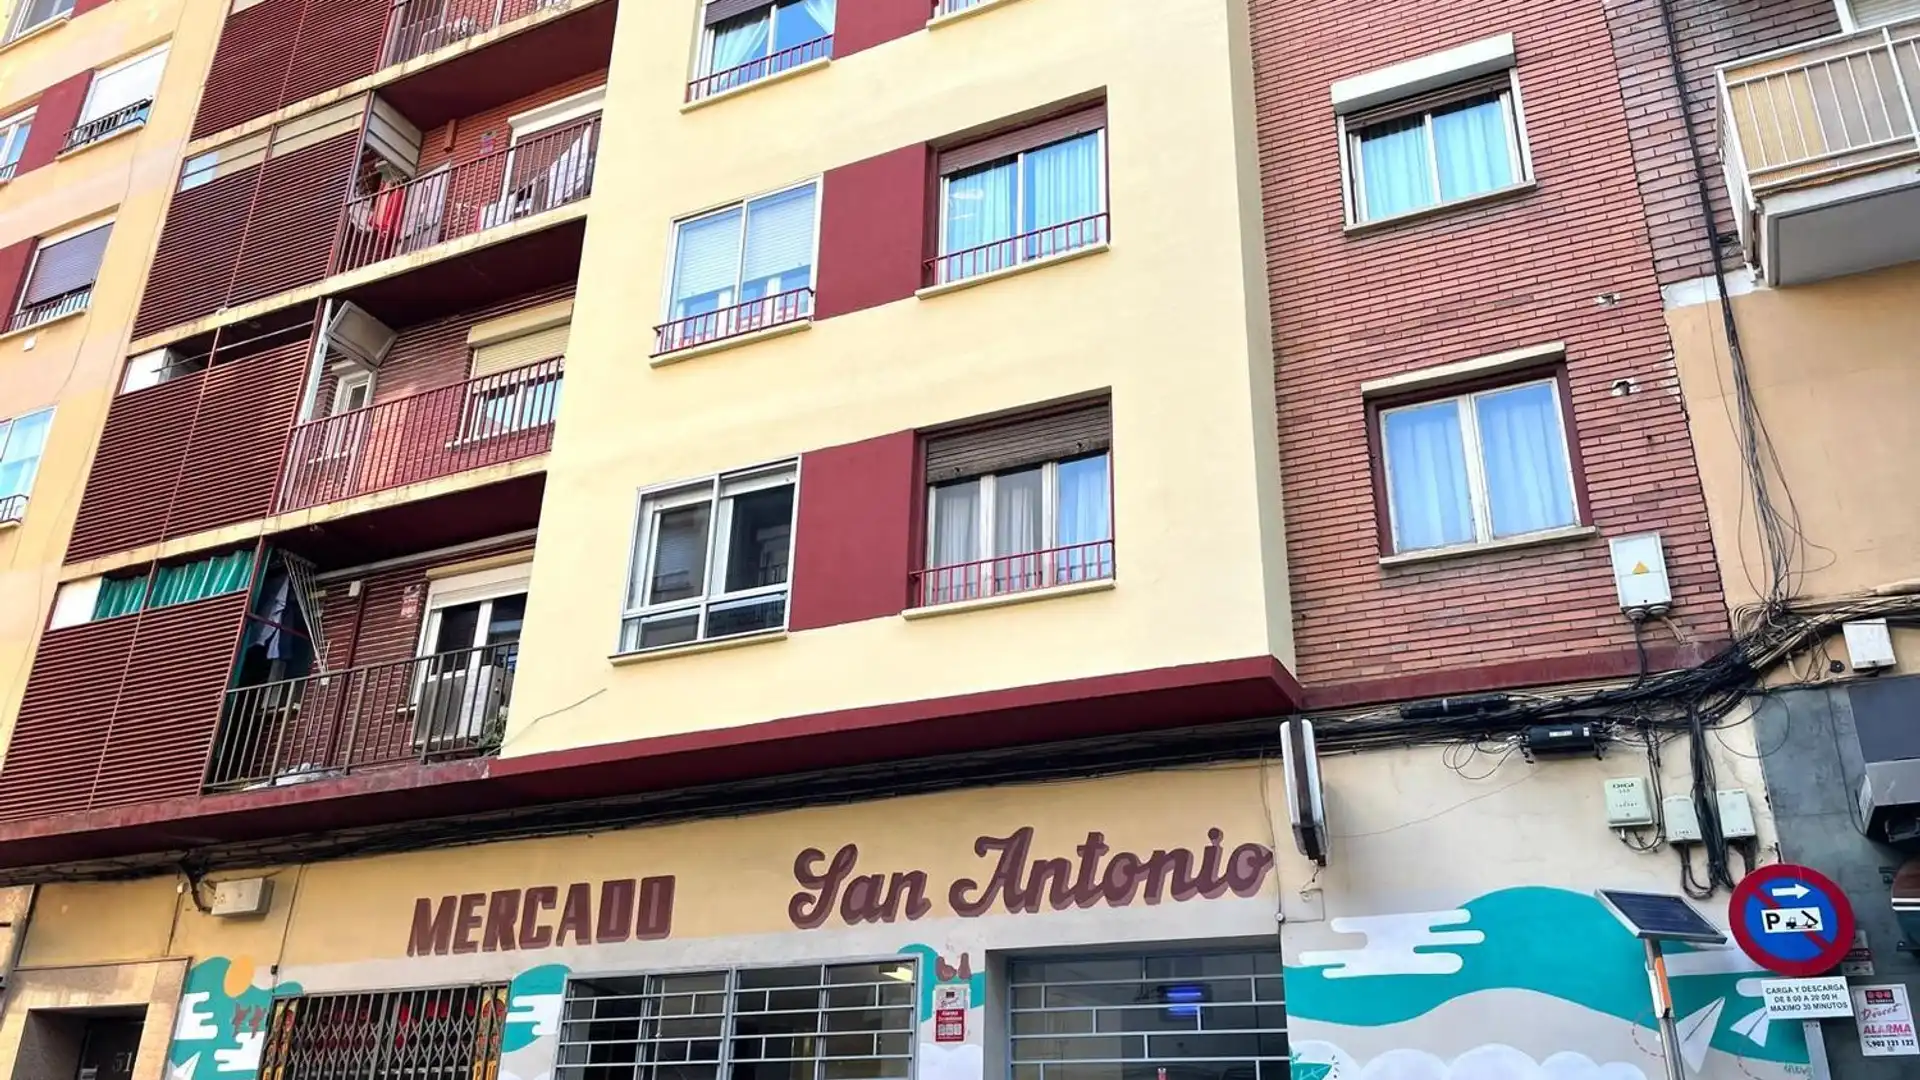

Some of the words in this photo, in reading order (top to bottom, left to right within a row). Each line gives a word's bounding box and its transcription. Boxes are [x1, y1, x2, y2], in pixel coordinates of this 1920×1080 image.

[788, 843, 932, 930] San
[948, 826, 1274, 918] Antonio
[406, 875, 676, 957] MERCADO
[1765, 912, 1781, 930] P
[1765, 986, 1794, 995] CARGA
[1795, 985, 1800, 993] Y
[1801, 983, 1845, 993] DESCARGA
[1774, 996, 1785, 1004] DE
[1803, 995, 1810, 1003] A
[1831, 993, 1838, 1001] H
[1770, 1003, 1801, 1012] MAXIMO
[1812, 1001, 1848, 1010] MINUTOS
[1863, 1023, 1912, 1034] ALARMA
